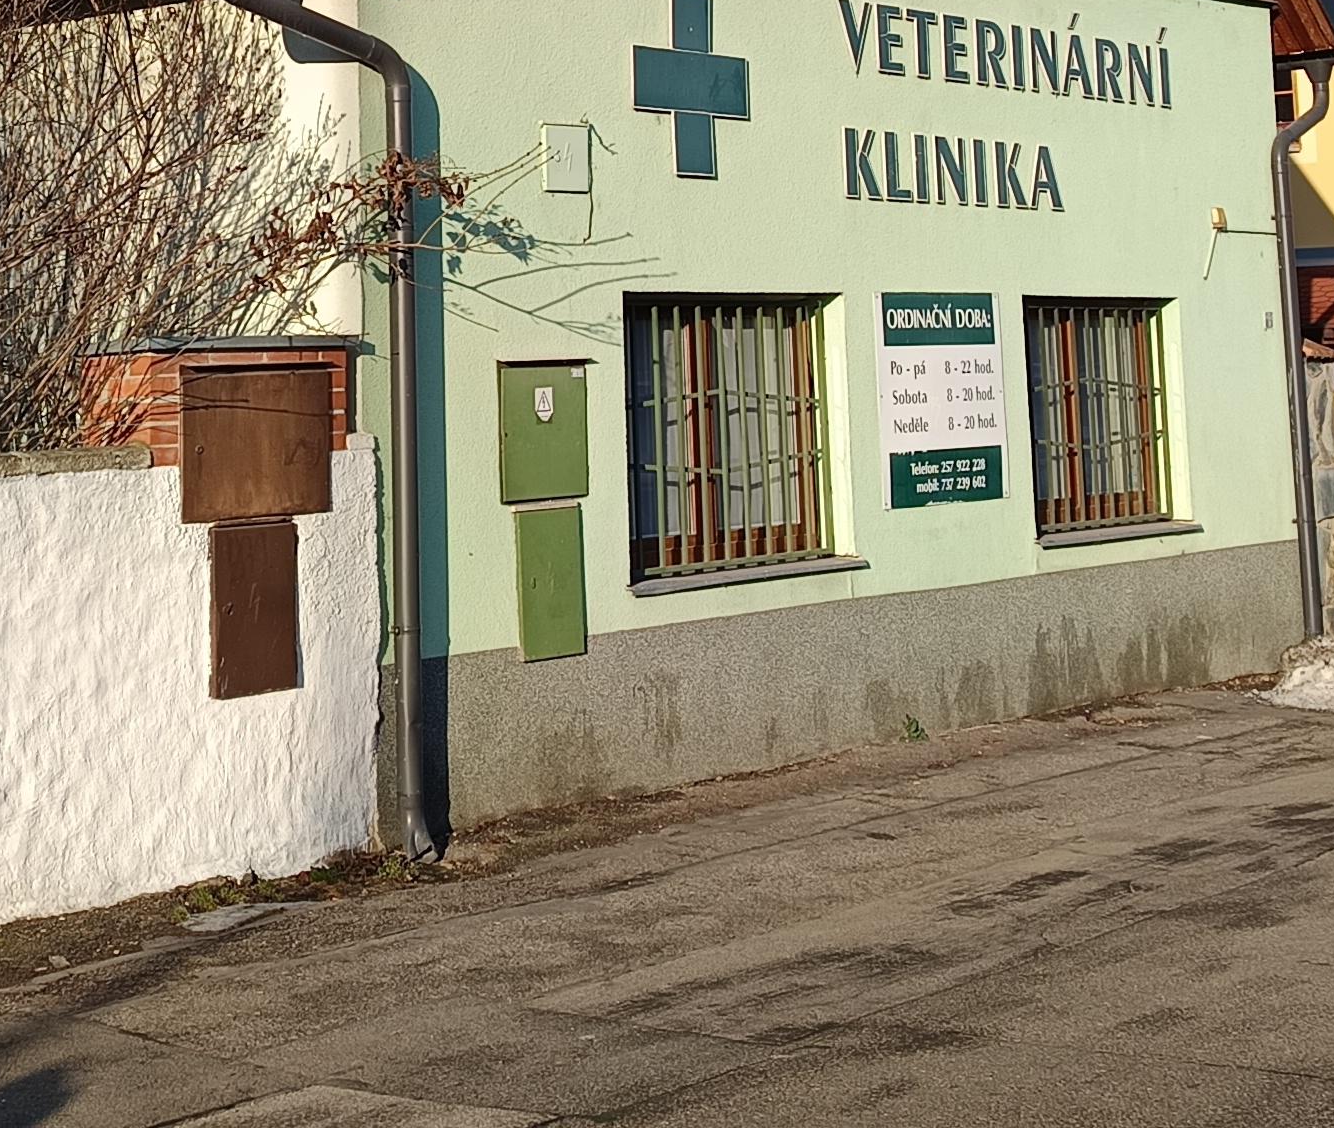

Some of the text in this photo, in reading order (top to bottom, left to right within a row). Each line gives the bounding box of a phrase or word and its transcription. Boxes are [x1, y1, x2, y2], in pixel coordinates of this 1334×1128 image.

[841, 125, 1065, 212] KLINIKA
[886, 303, 991, 329] ORDINAČNÍ DOBA:
[890, 360, 903, 375] Po
[914, 360, 926, 380] pá
[945, 360, 951, 375] 8
[961, 360, 972, 374] 22
[974, 359, 994, 374] hod.
[892, 388, 928, 406] Sobota
[947, 388, 953, 402] 8
[962, 388, 973, 402] 20
[976, 385, 995, 401] hod.
[894, 416, 929, 434] Neděle
[948, 416, 954, 431] 8
[964, 415, 975, 430] 20
[978, 412, 997, 428] hod.
[910, 461, 939, 476] Telefon:
[940, 460, 954, 474] 257
[956, 459, 970, 473] 922
[916, 478, 939, 494] mobil:
[956, 476, 971, 490] 239
[972, 475, 986, 489] 602
